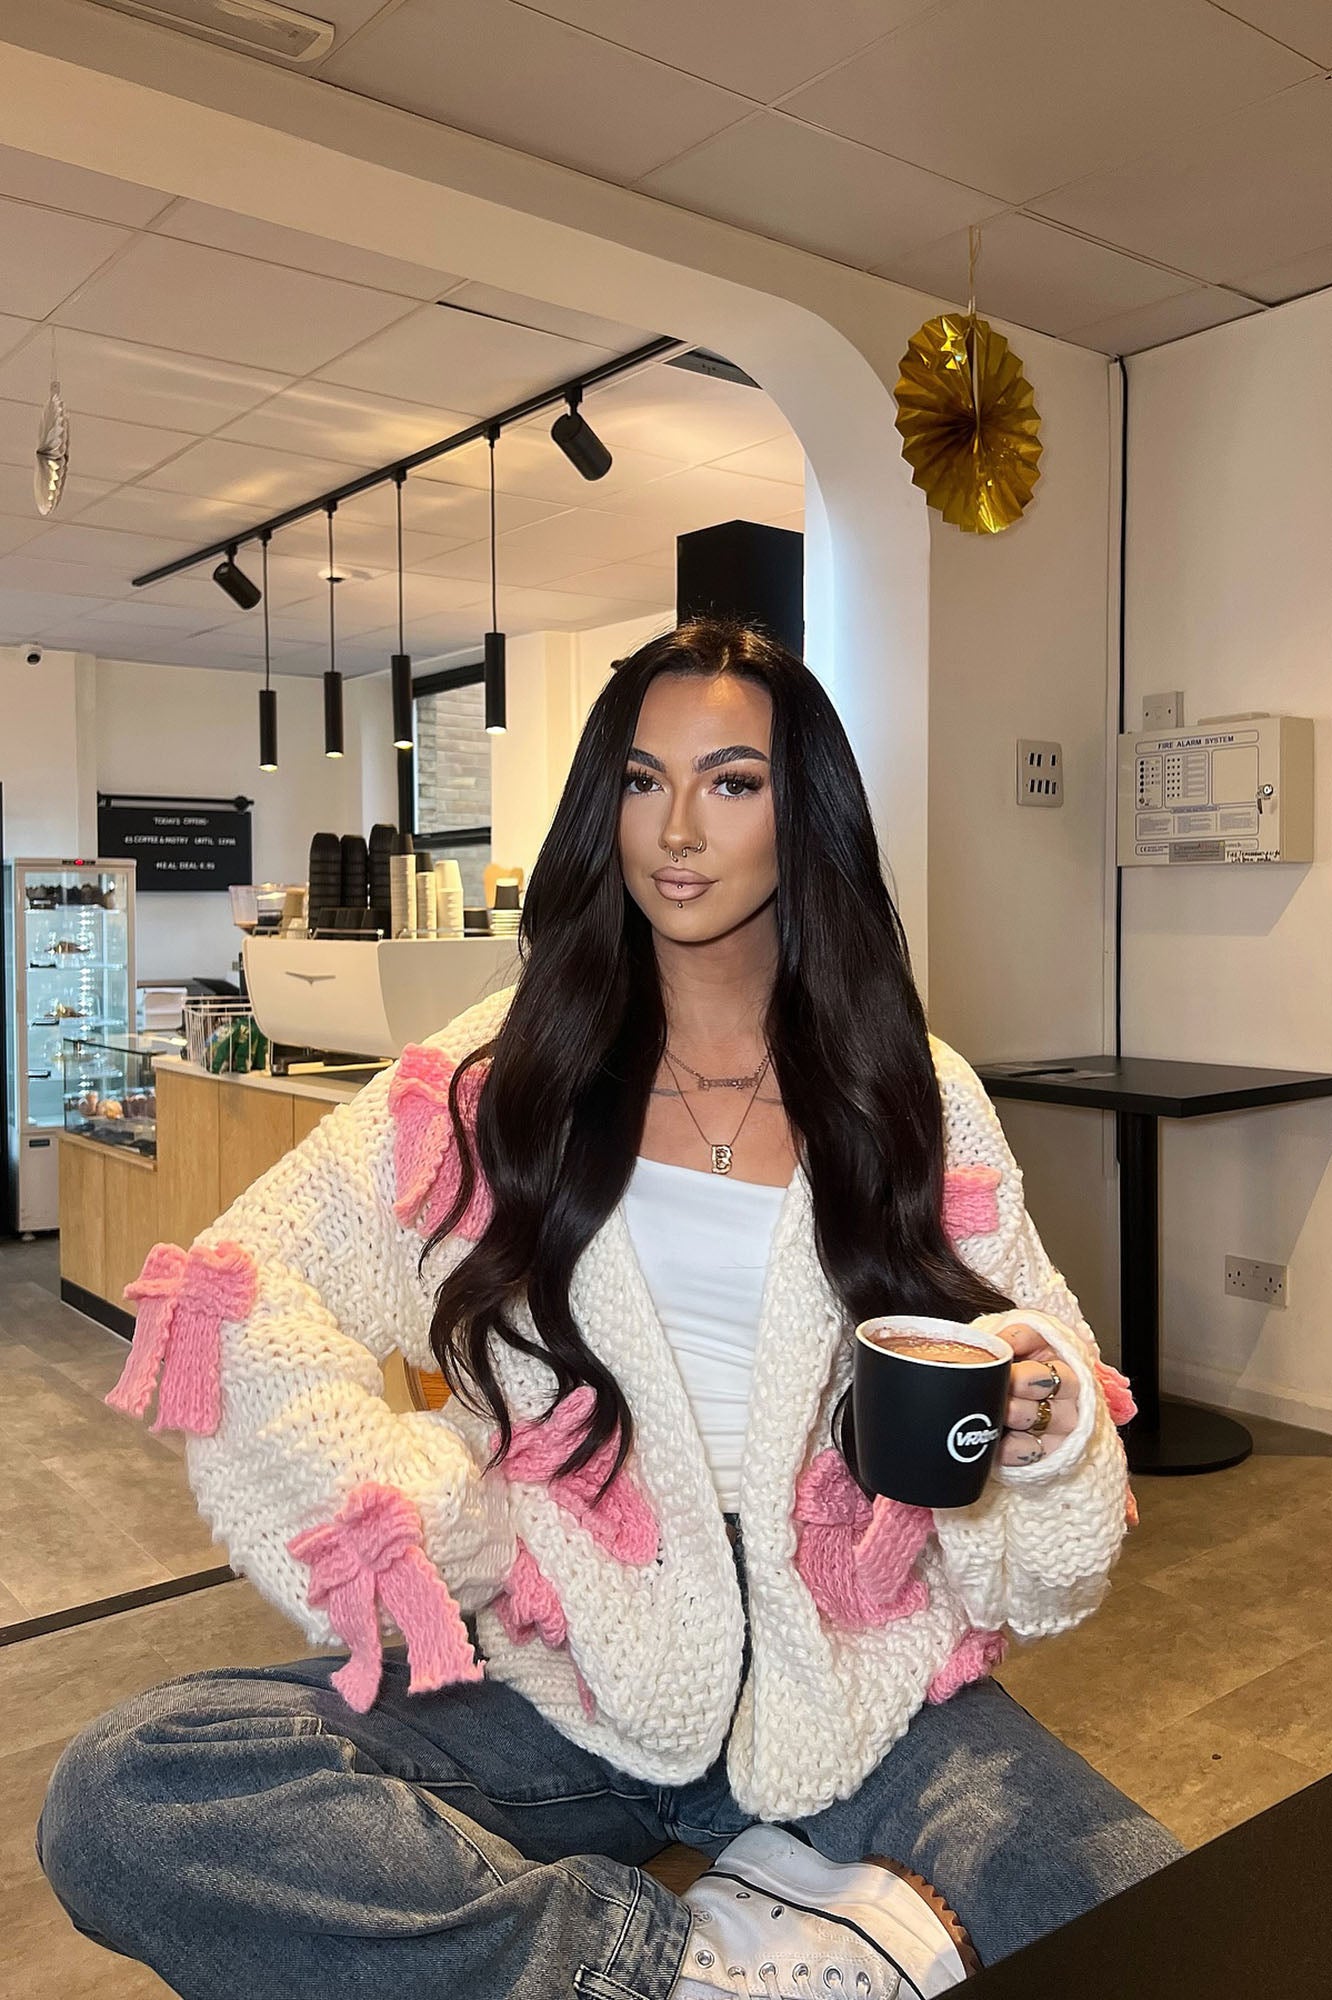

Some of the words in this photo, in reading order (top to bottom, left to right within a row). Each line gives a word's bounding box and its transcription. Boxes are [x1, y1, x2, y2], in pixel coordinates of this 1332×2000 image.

[1177, 739, 1201, 747] ALARM
[1204, 736, 1234, 745] SYSTEM
[156, 861, 177, 870] MEAL
[179, 861, 198, 870] DEAL
[711, 1144, 733, 1175] B
